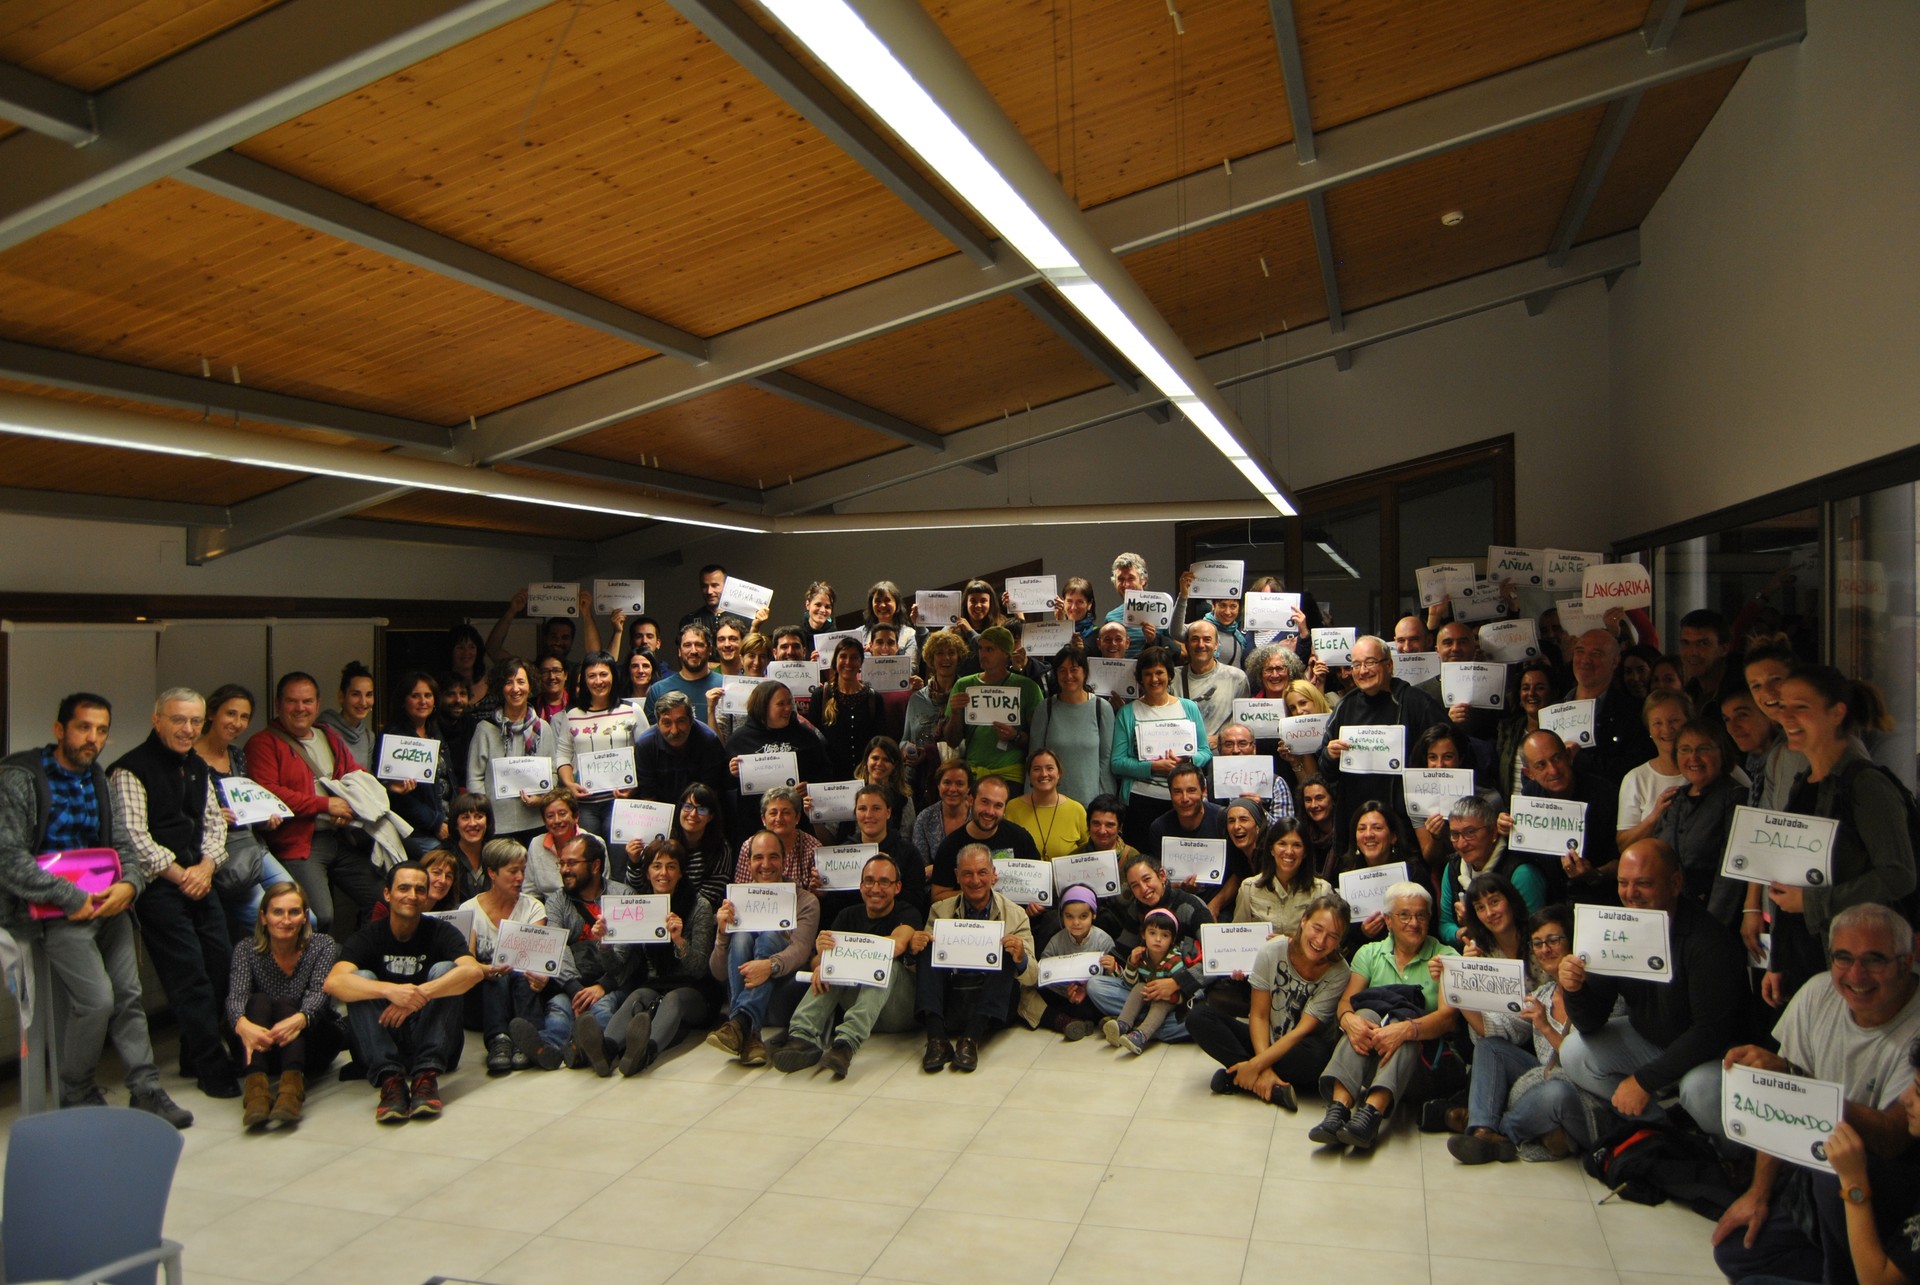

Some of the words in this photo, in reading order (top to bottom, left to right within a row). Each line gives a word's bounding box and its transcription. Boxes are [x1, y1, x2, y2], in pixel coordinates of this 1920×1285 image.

[1498, 557, 1534, 572] AÑUA
[1585, 579, 1650, 598] LANGARIKA
[1314, 637, 1349, 651] ELGEA
[392, 748, 432, 764] GAZETA
[1750, 829, 1822, 853] DALLO
[613, 905, 645, 921] LAB
[1604, 930, 1629, 943] ELA
